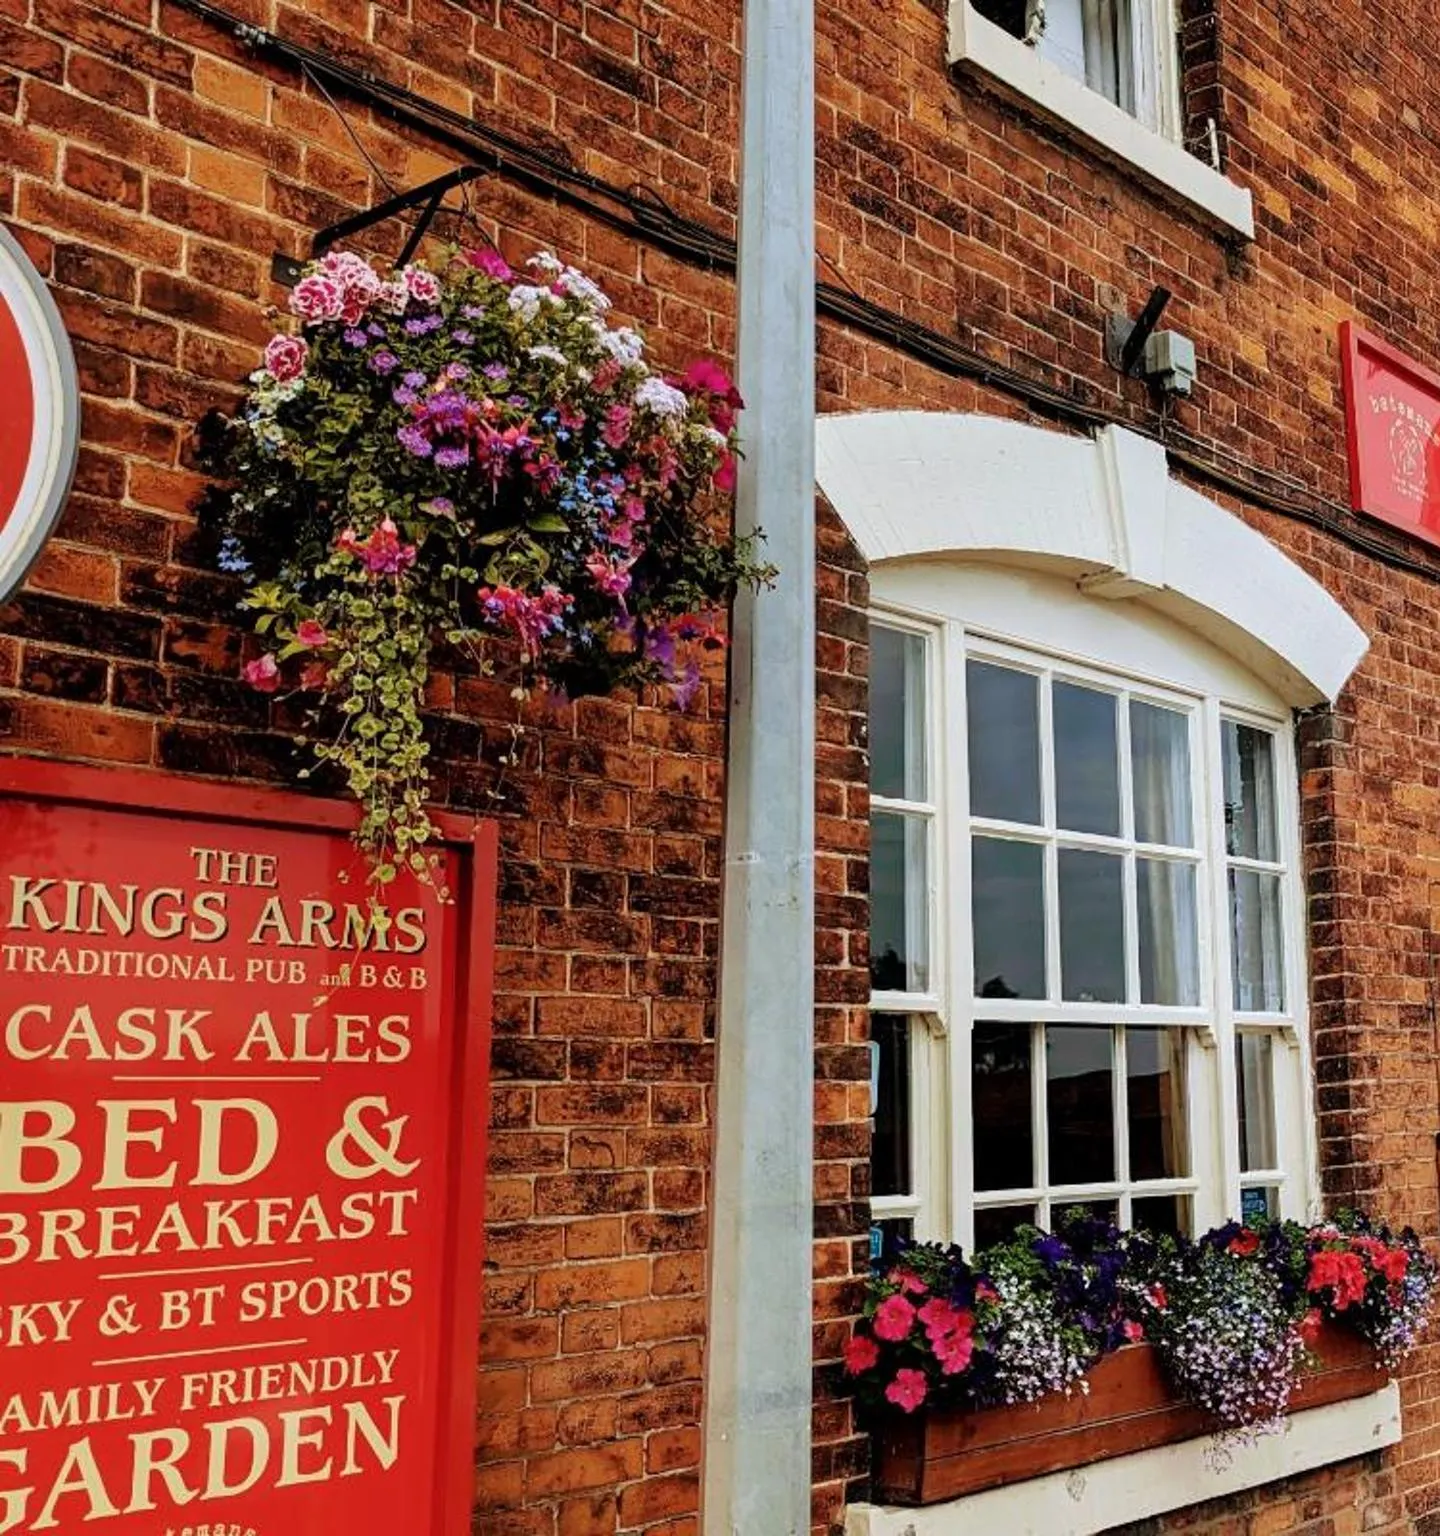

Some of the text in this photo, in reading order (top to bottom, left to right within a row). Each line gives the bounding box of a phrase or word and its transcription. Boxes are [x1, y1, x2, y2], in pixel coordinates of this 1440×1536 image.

[190, 845, 280, 888] THE
[5, 874, 428, 955] KINGS ARMS
[1, 944, 236, 983] TRADITIONAL
[245, 957, 307, 986] PUB
[4, 1003, 413, 1065] CASK ALES
[0, 1095, 421, 1195] BED &
[0, 1189, 418, 1266] BREAKFAST
[0, 1267, 414, 1347] KY & BT SPORTS
[0, 1348, 401, 1436] AMILY FRIENDLY
